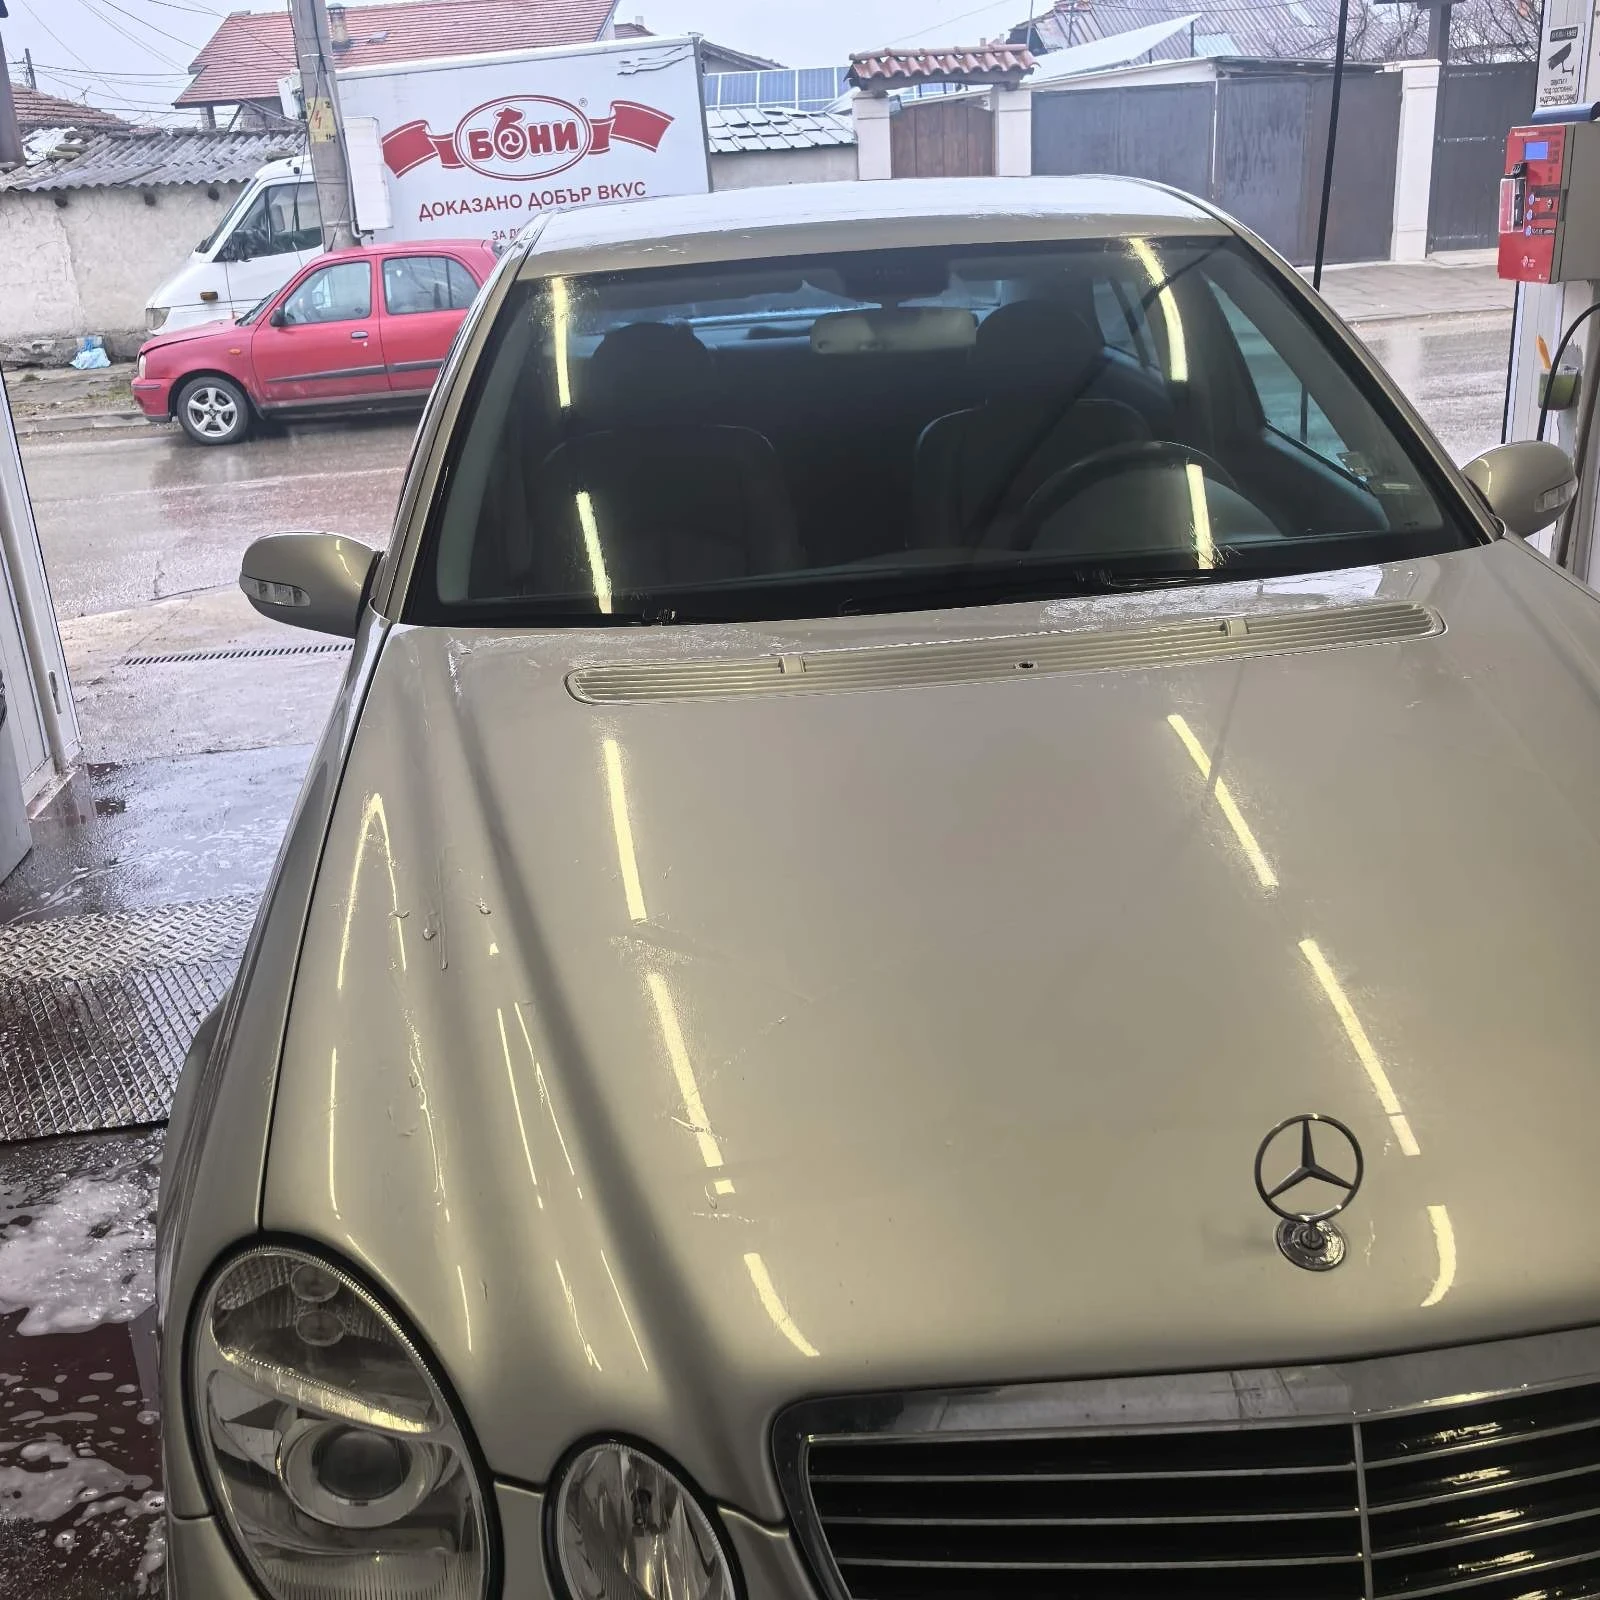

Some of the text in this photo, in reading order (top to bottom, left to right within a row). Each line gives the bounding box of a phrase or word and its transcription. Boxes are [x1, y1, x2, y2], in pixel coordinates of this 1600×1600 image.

[467, 107, 580, 161] БОНИ
[419, 181, 646, 221] ДОКАЗАНО ДОБЪР ВКУС
[492, 230, 506, 240] ЗА
